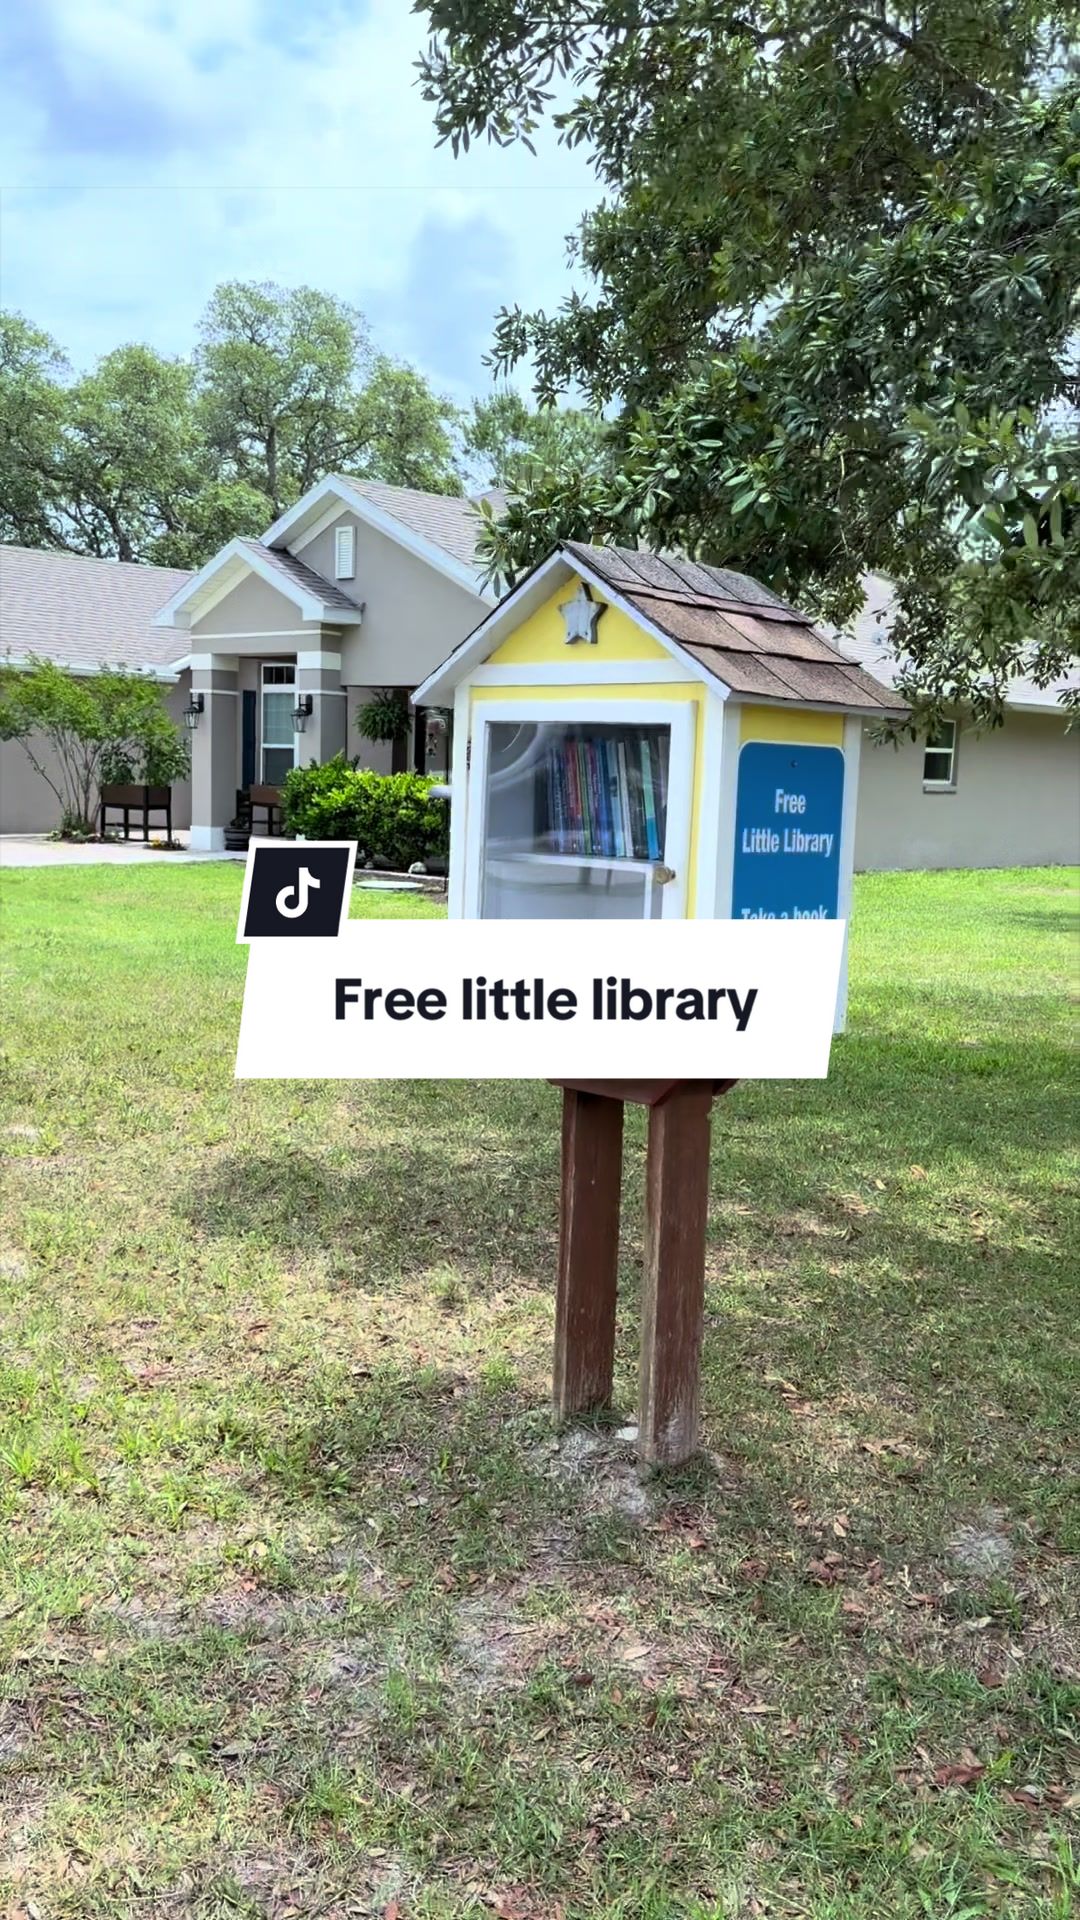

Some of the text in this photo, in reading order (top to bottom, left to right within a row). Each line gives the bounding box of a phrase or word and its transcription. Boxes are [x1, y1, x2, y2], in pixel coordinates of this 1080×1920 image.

[774, 788, 807, 814] Free
[742, 828, 834, 858] Little Library
